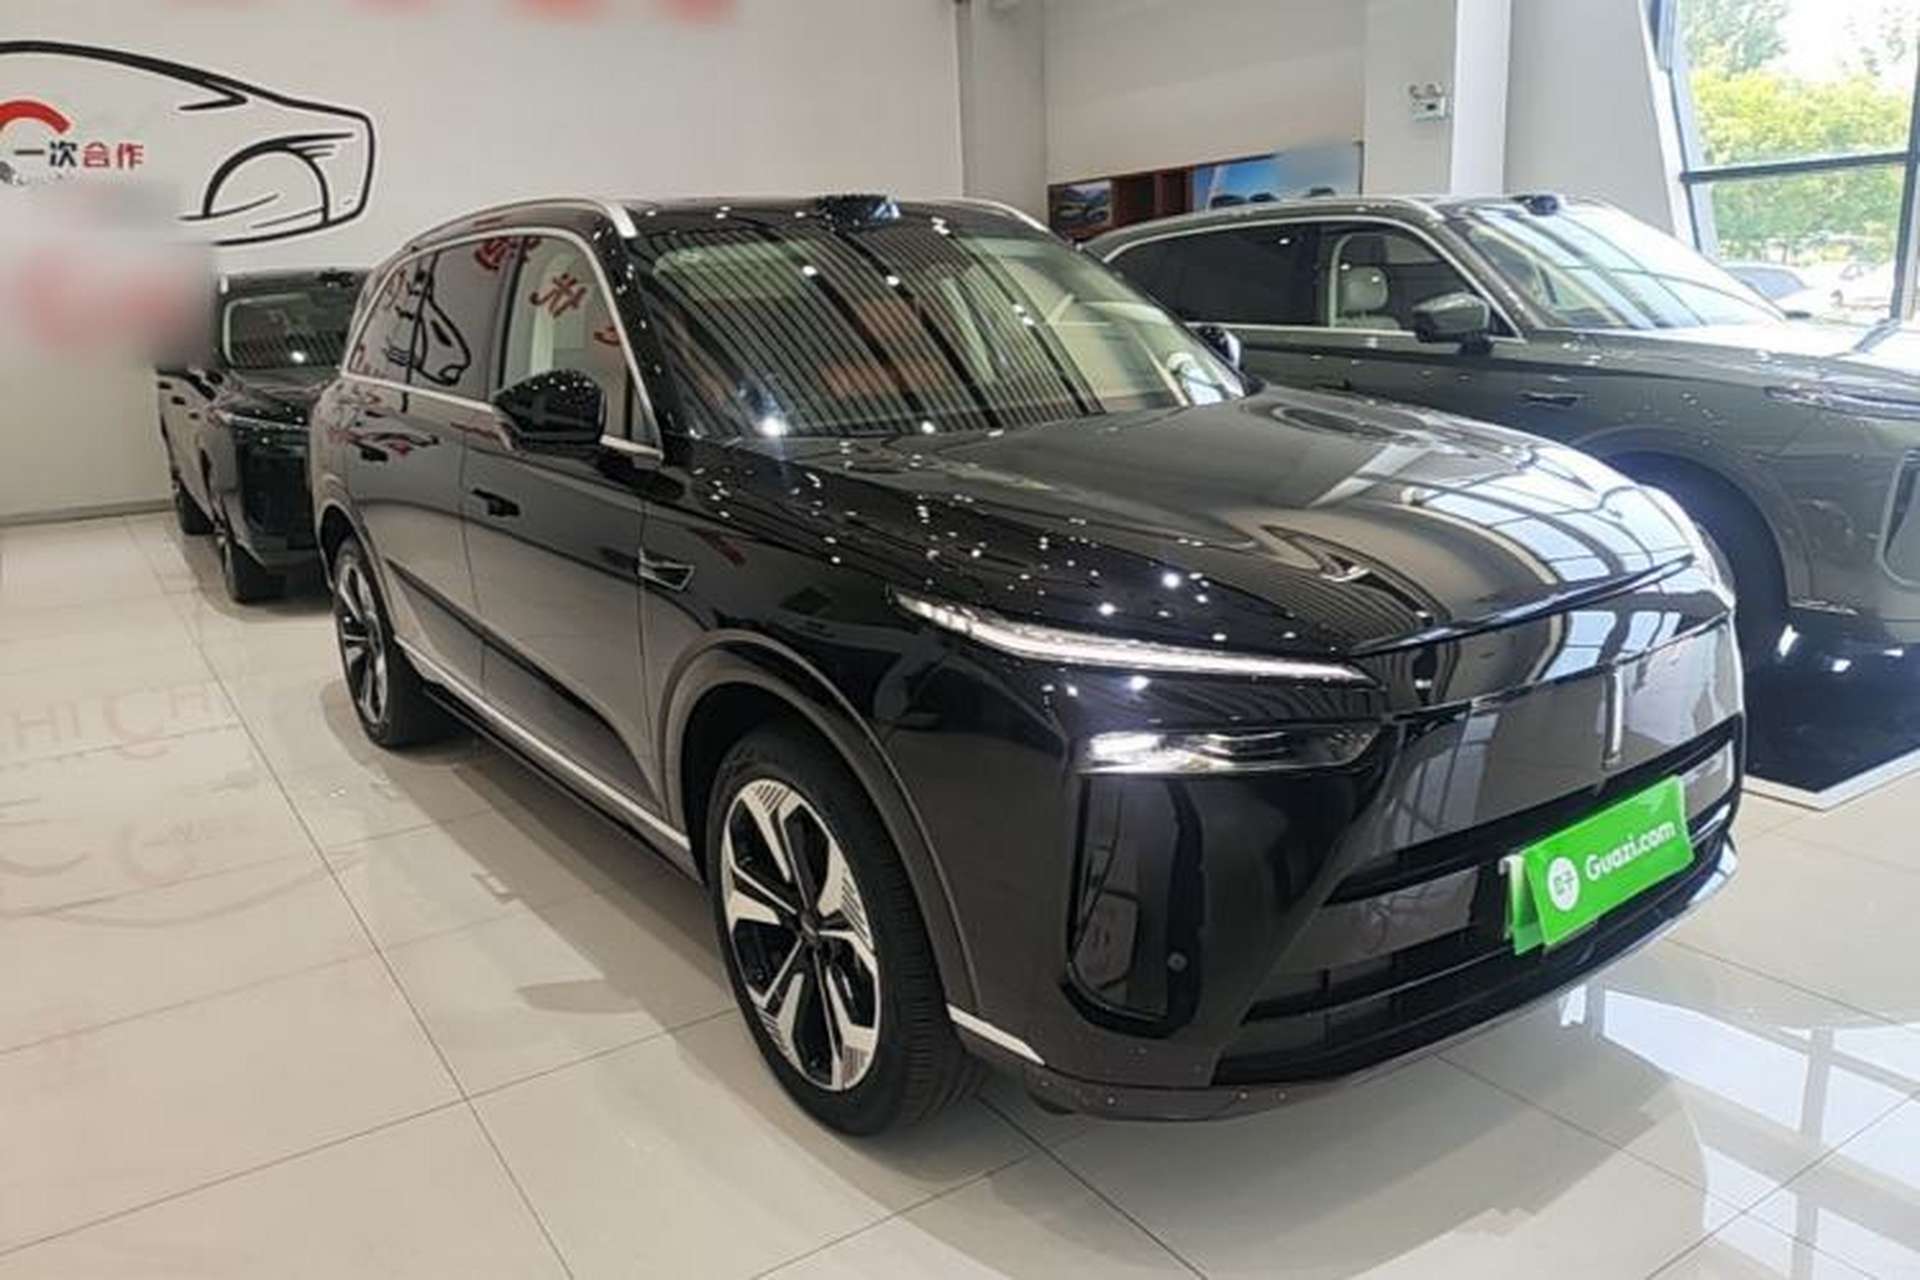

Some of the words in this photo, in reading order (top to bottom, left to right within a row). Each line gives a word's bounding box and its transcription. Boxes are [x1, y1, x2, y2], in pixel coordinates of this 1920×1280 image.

[13, 141, 144, 169] 一次合作
[1585, 821, 1676, 881] Guazi.com
